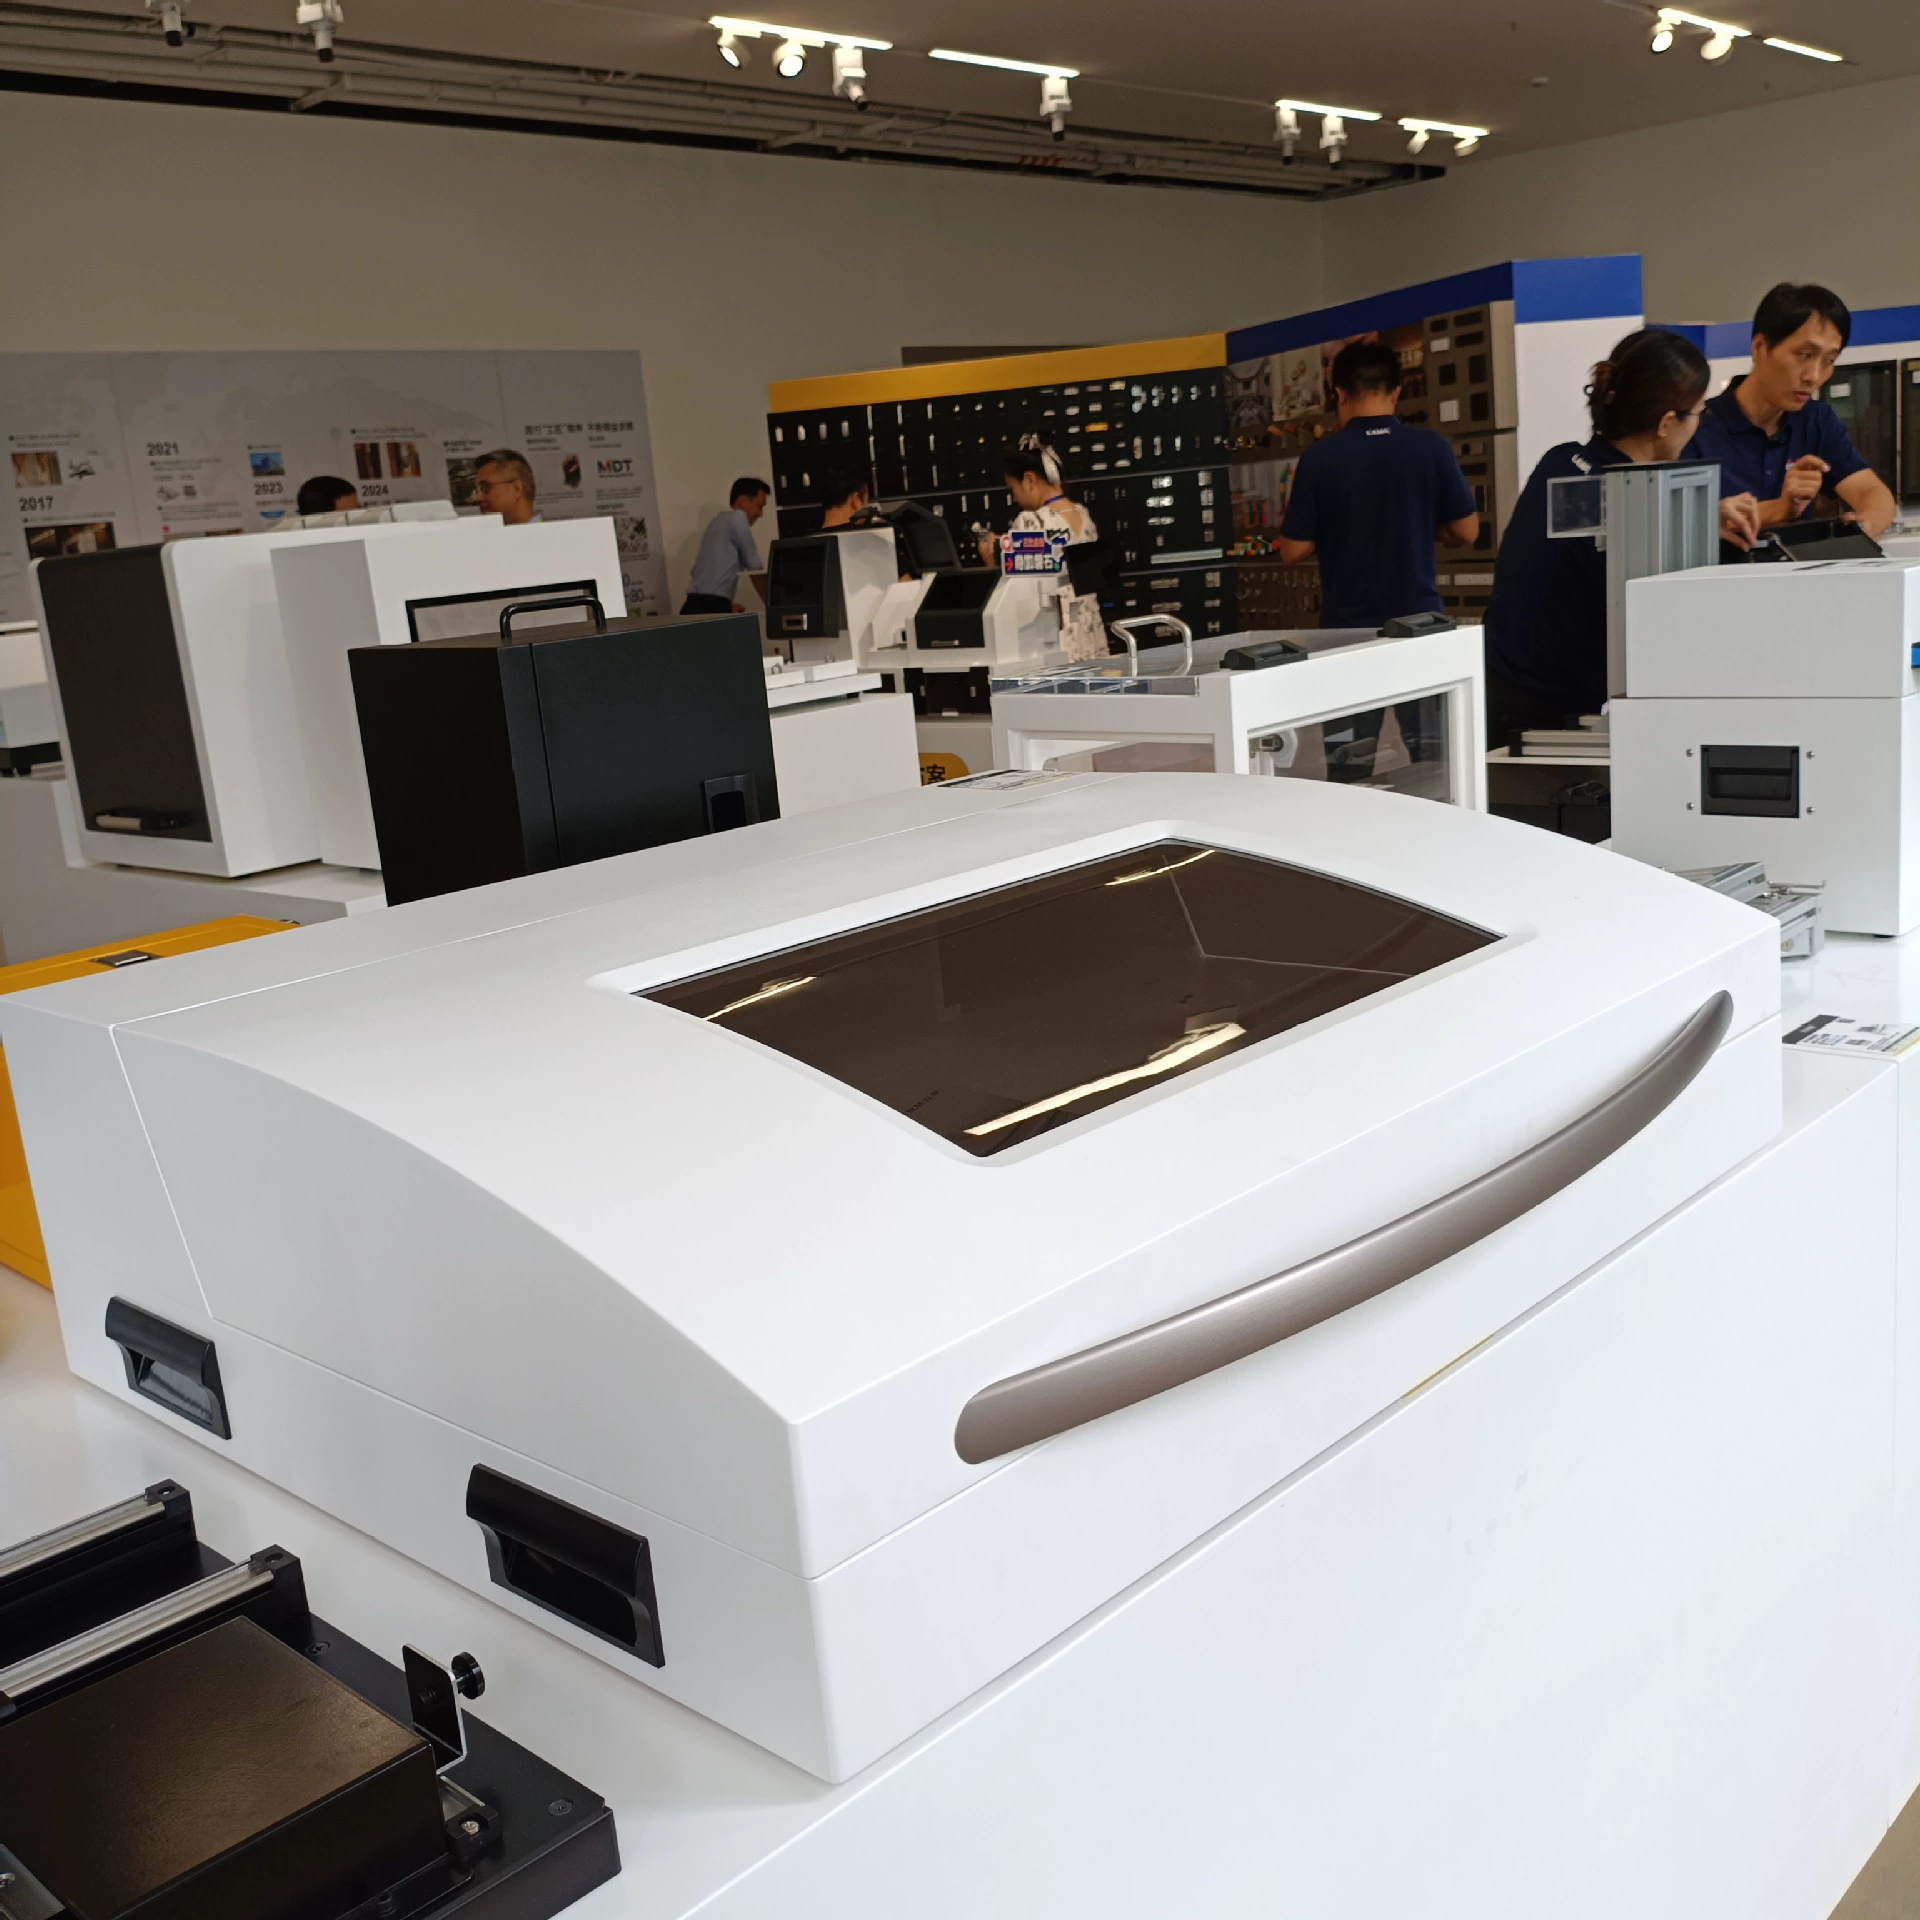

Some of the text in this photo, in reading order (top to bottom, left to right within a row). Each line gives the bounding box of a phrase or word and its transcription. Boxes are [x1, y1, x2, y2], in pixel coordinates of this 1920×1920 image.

[147, 442, 179, 456] 2021
[597, 459, 633, 473] MDT
[254, 481, 283, 495] 2023
[362, 484, 389, 497] 2024
[19, 496, 54, 511] 2017
